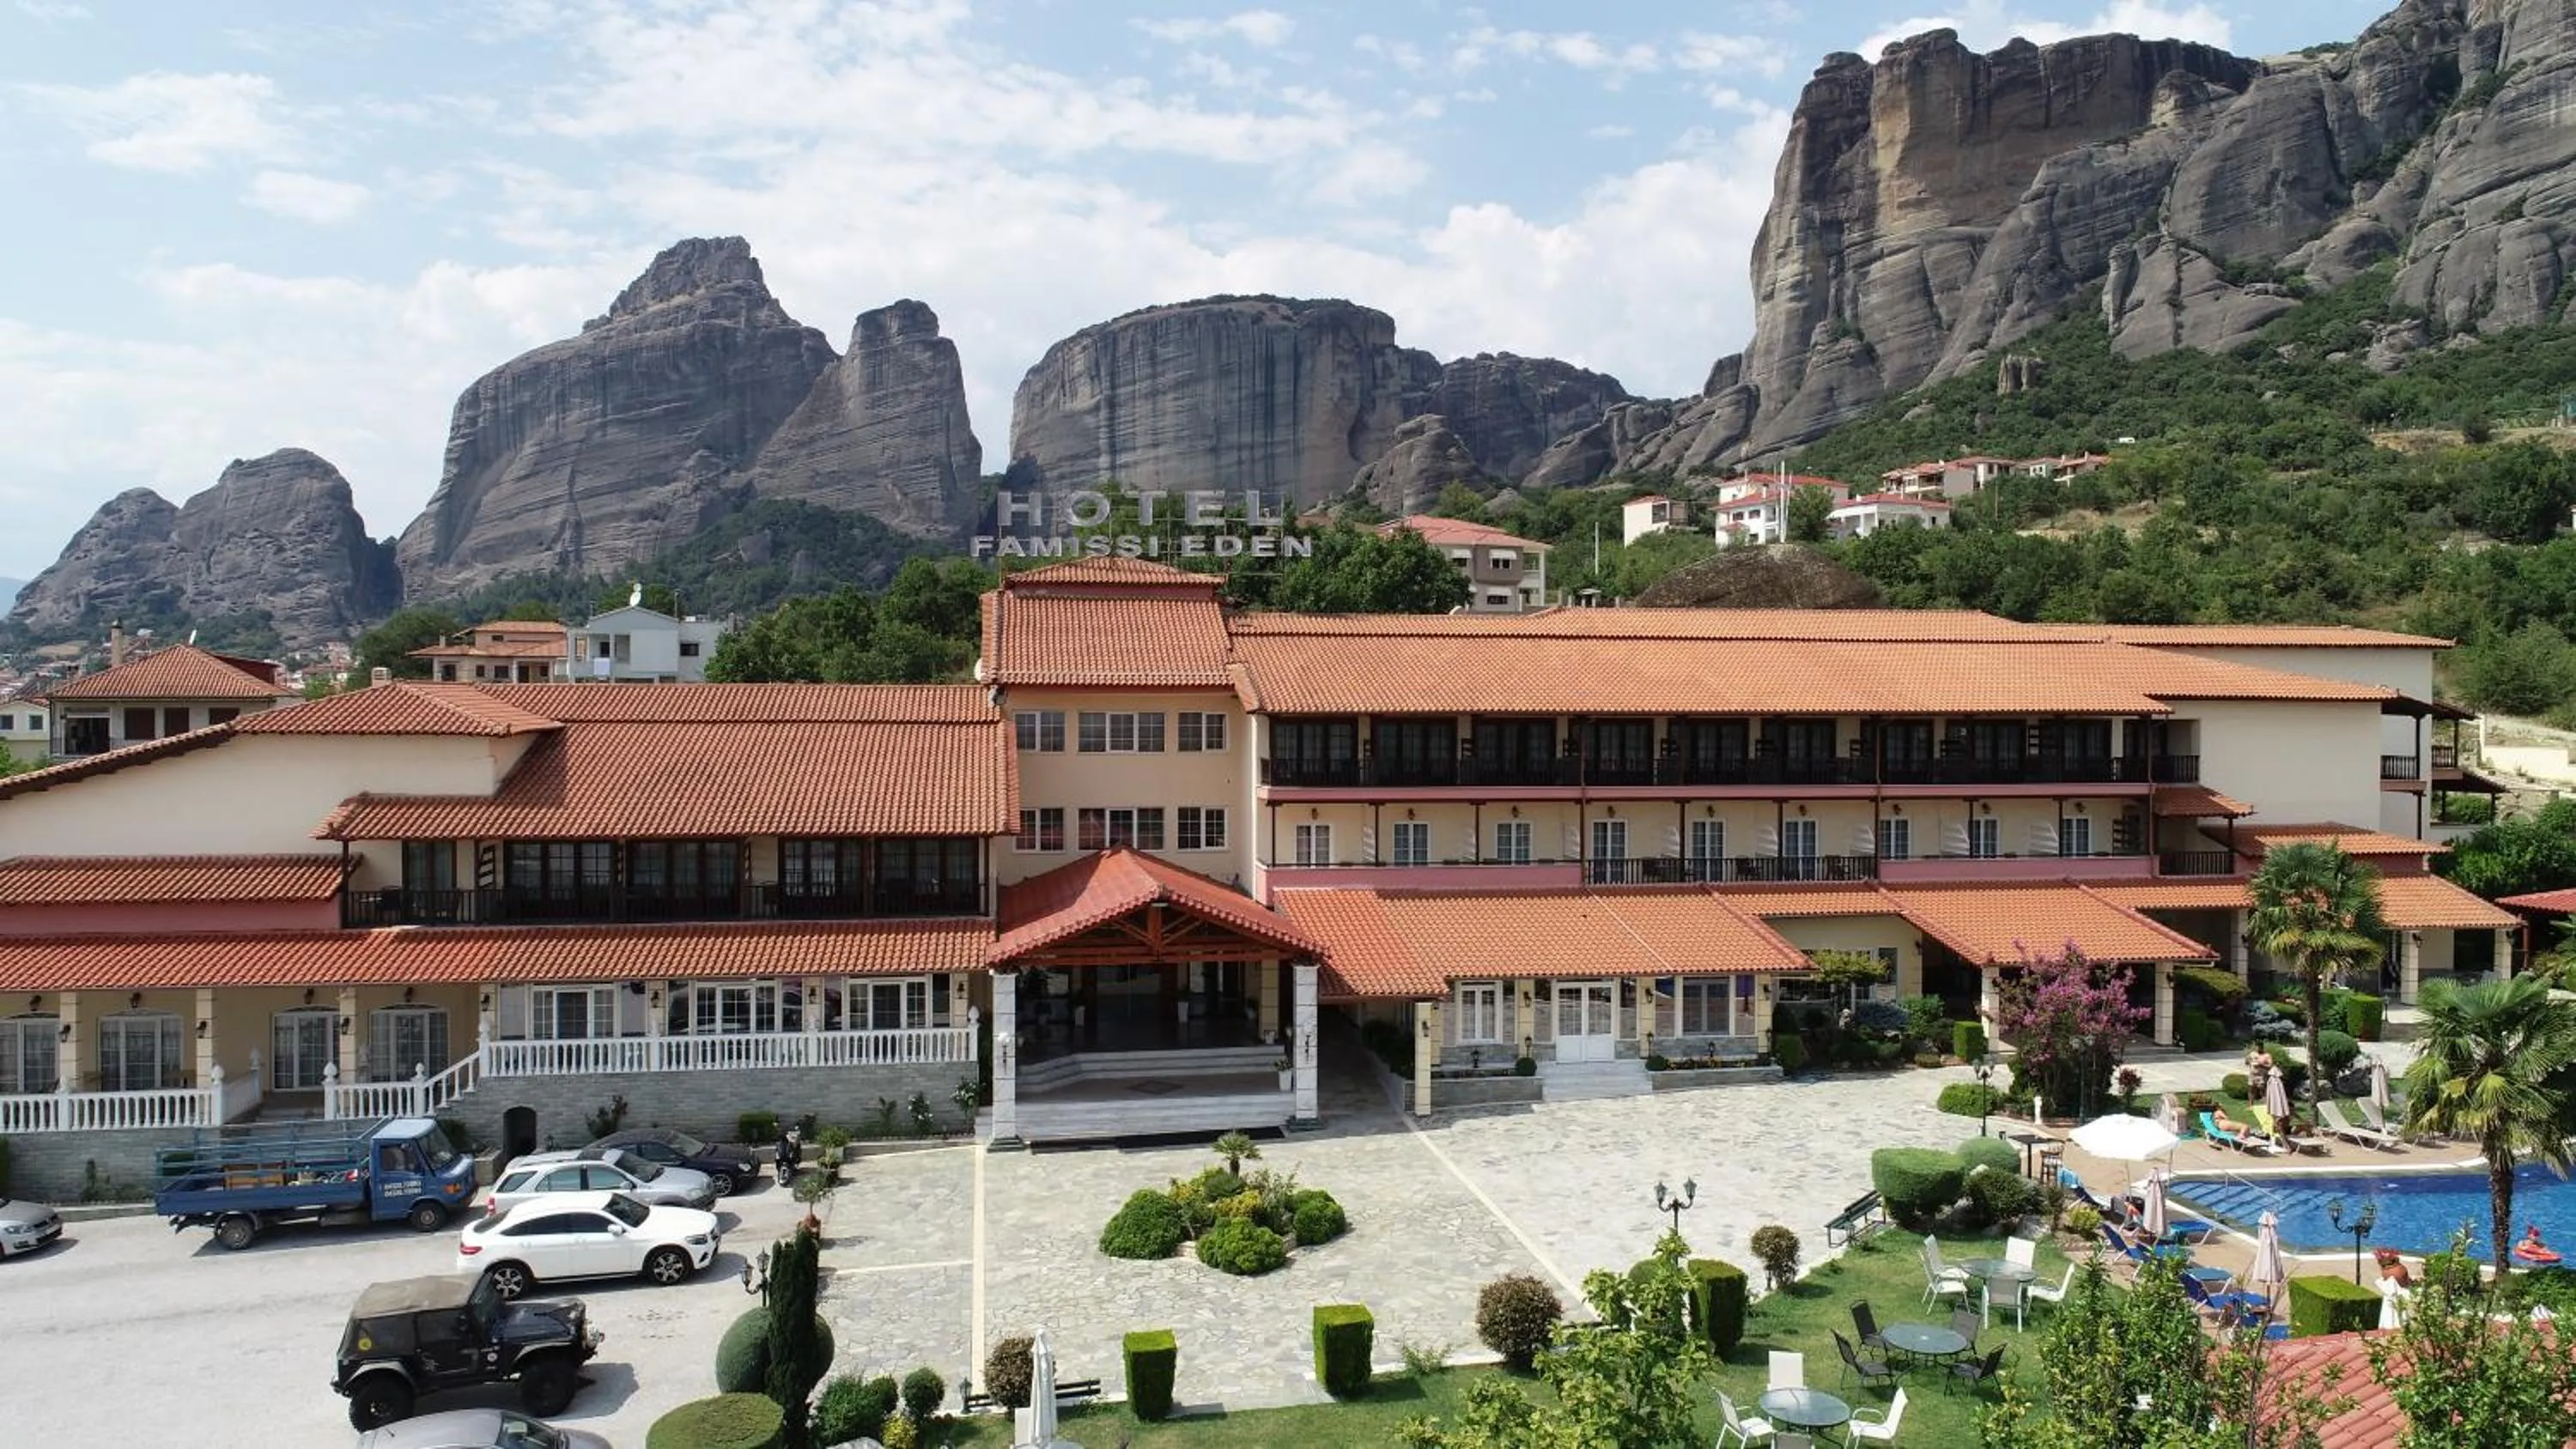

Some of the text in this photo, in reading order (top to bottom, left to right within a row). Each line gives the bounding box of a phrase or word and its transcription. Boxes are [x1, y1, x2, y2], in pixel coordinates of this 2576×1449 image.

[998, 489, 1285, 526] HOTEL
[969, 535, 1312, 558] FAMISSI EDEN
